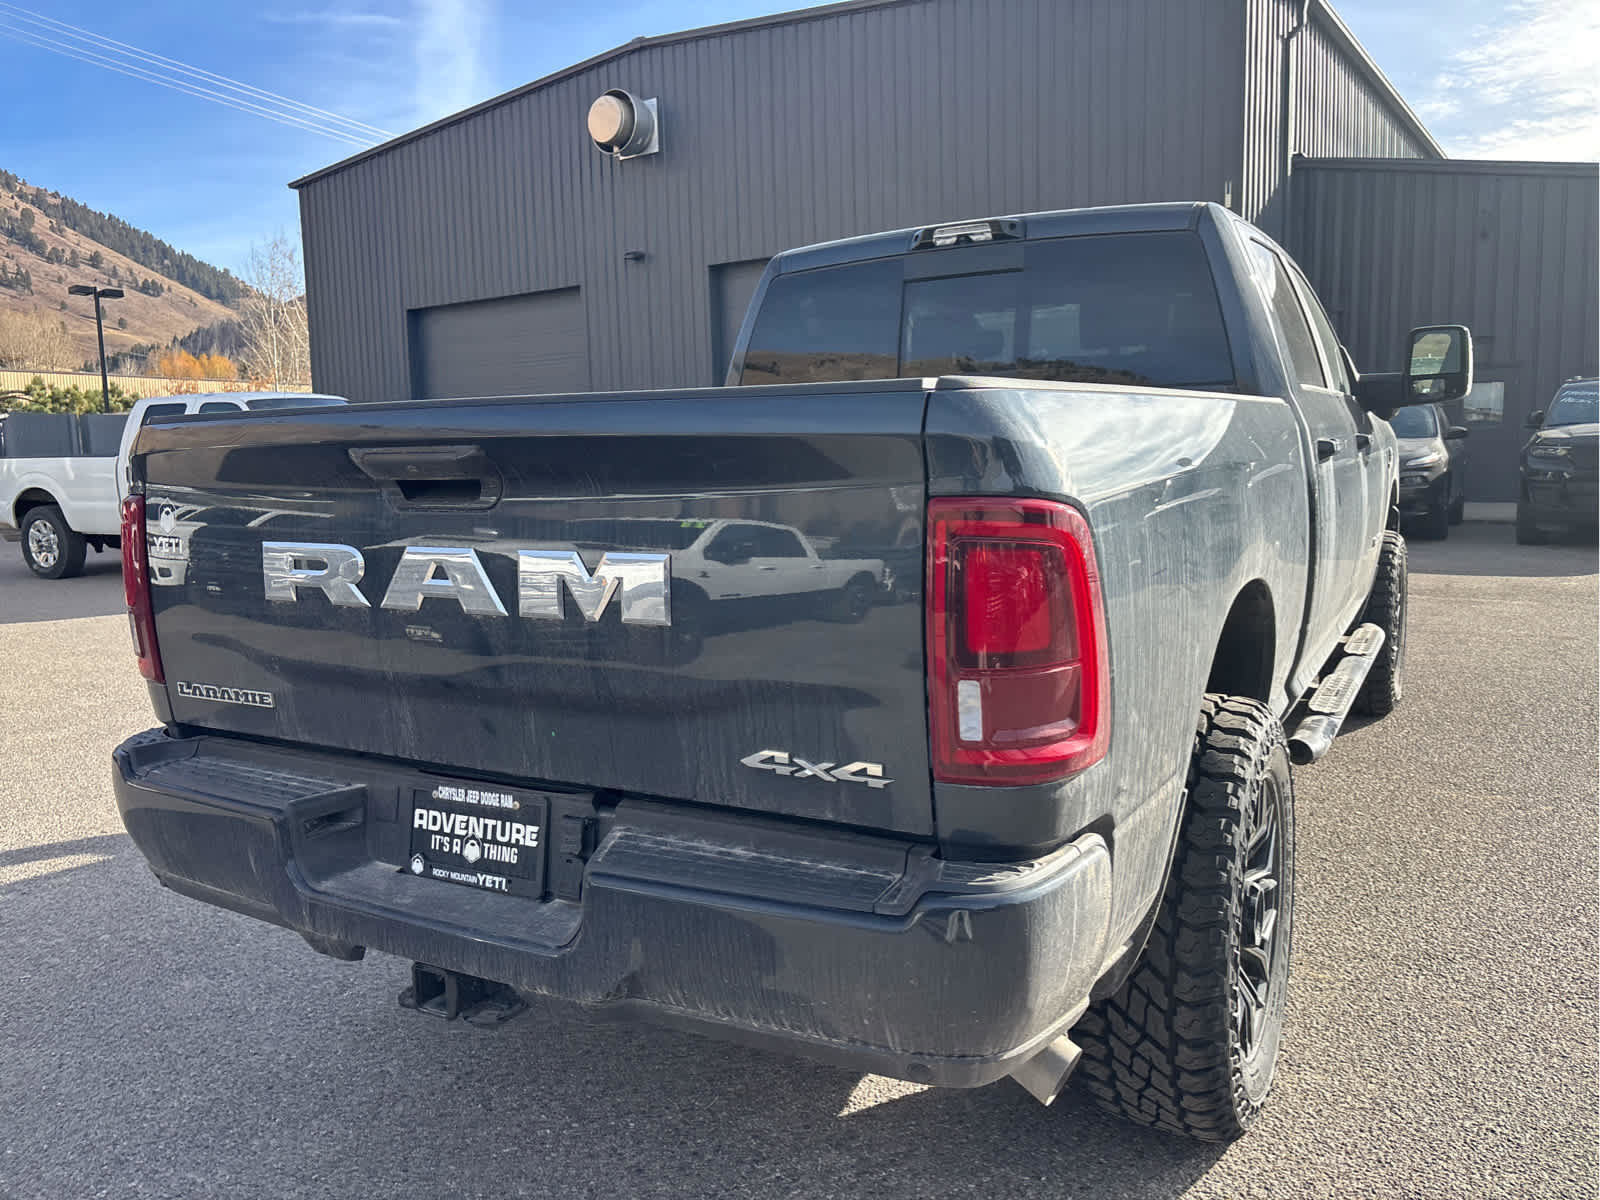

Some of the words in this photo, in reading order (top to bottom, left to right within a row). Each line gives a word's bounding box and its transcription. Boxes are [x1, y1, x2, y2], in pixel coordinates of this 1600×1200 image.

[152, 535, 183, 554] YETI
[262, 541, 672, 627] RAM
[176, 681, 276, 708] LARAMIE
[438, 785, 466, 803] CHRYSLER
[466, 789, 480, 804] JEEP
[480, 791, 500, 807] DODGE
[500, 793, 513, 809] RAM
[413, 808, 540, 848] ADVENTURE
[431, 834, 451, 853] IT'S
[452, 838, 462, 855] A
[483, 843, 519, 865] THING
[432, 867, 450, 879] ROCKY
[450, 871, 477, 884] MOUNTAIN
